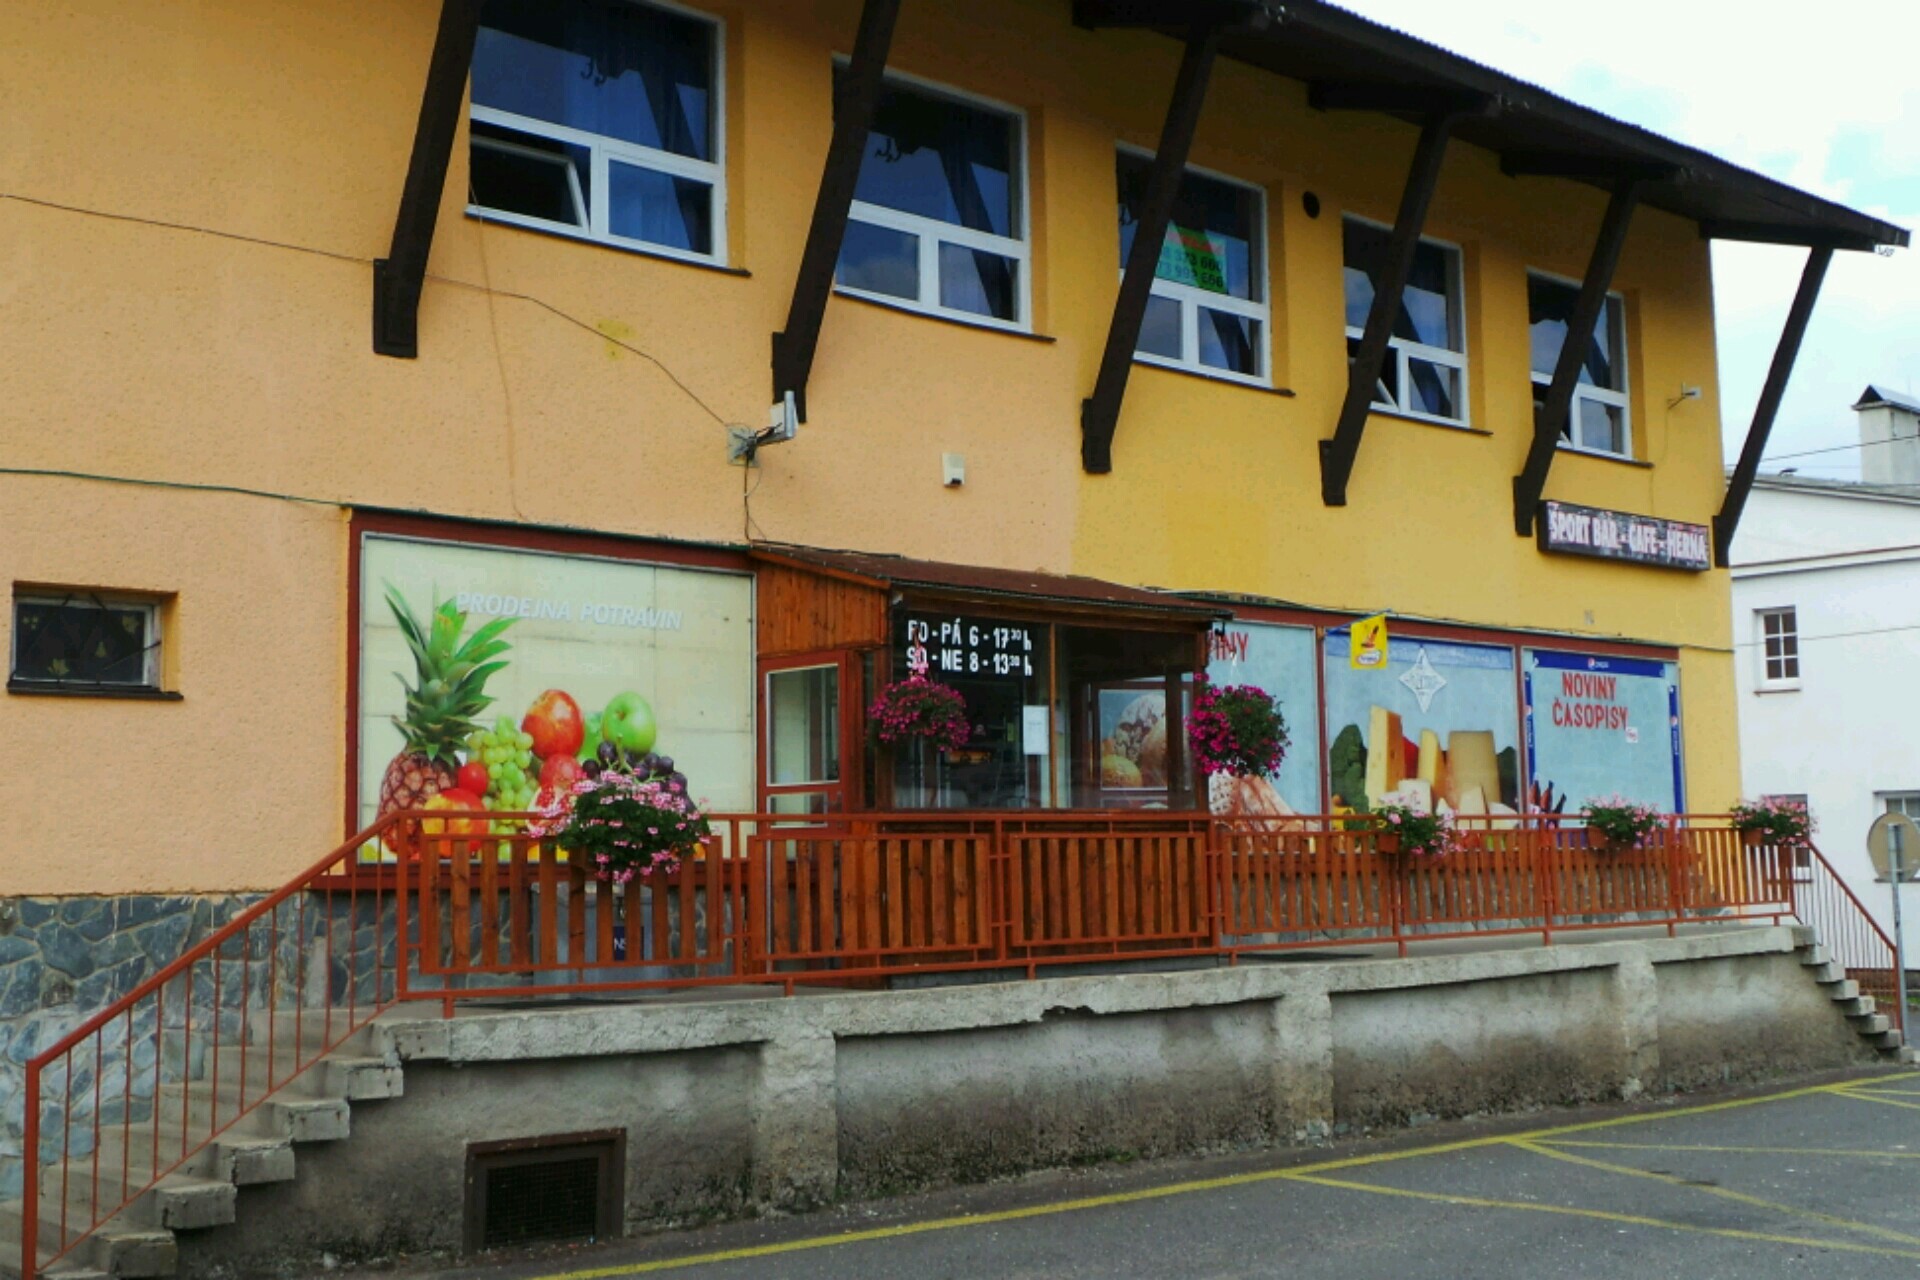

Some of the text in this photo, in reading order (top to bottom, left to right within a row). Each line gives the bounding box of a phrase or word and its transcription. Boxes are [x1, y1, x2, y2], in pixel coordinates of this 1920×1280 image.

[1549, 509, 1590, 545] SPORT
[1592, 517, 1620, 549] BAR
[1629, 523, 1658, 554] CAFE
[1666, 529, 1707, 562] HERNA
[455, 592, 683, 630] PRODEJNA POTRAVIN
[1207, 630, 1249, 663] INY
[1562, 671, 1617, 701] NOVINY
[1552, 697, 1628, 731] ČASOPISY
